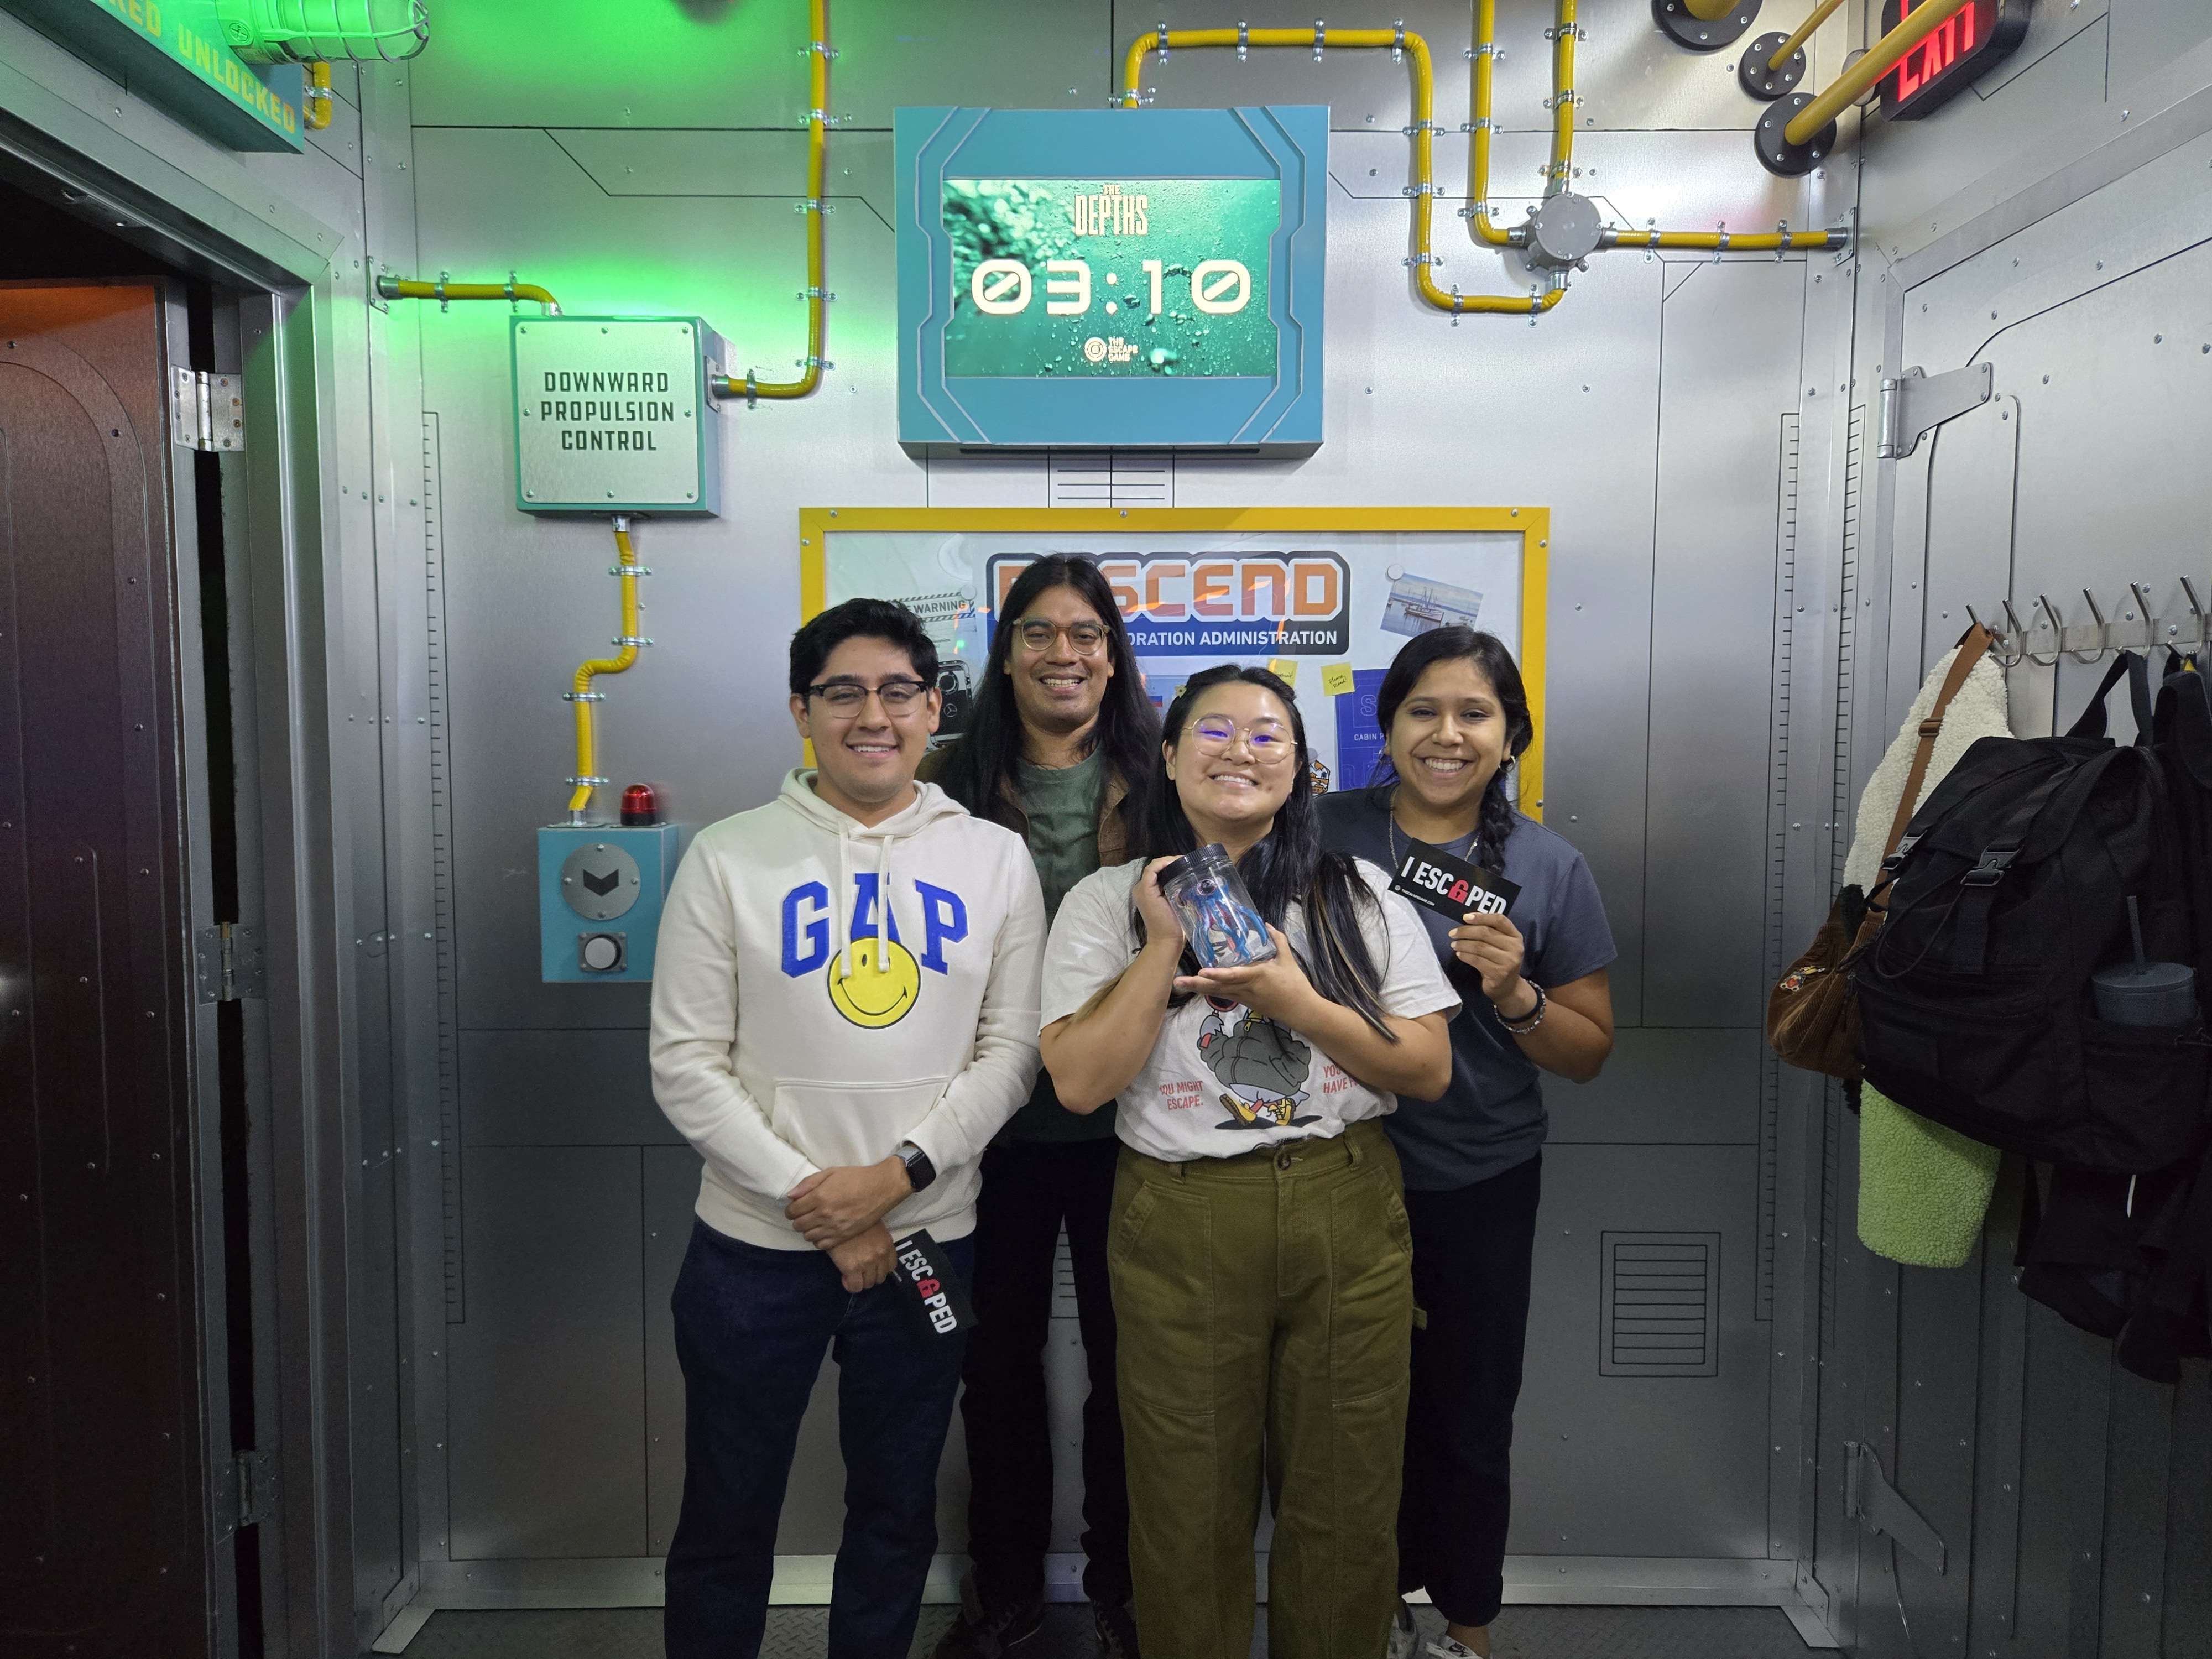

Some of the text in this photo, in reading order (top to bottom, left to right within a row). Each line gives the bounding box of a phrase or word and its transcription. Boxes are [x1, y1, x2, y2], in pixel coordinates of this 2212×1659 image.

[178, 23, 295, 134] UNLOCKED
[1104, 184, 1120, 195] THE
[1075, 195, 1147, 235] DEPTHS
[972, 259, 1251, 315] 03:10
[1108, 337, 1124, 346] THE
[1108, 345, 1138, 354] ESCAPE
[1108, 353, 1130, 362] GAME
[544, 372, 669, 392] DOWNWARD
[541, 401, 674, 421] PROPULSION
[561, 430, 656, 451] CONTROL
[999, 564, 1338, 616] SCEND
[914, 599, 966, 614] WARNING
[1199, 631, 1337, 645] ADMINISTRATION
[1354, 733, 1377, 742] CABIN
[1401, 856, 1415, 878] I
[781, 872, 969, 979] GAP
[1159, 1080, 1203, 1095] YOU MIGHT
[1323, 1077, 1348, 1093] HAVE
[1167, 1094, 1204, 1110] ESCAPE.
[895, 1240, 913, 1251] I
